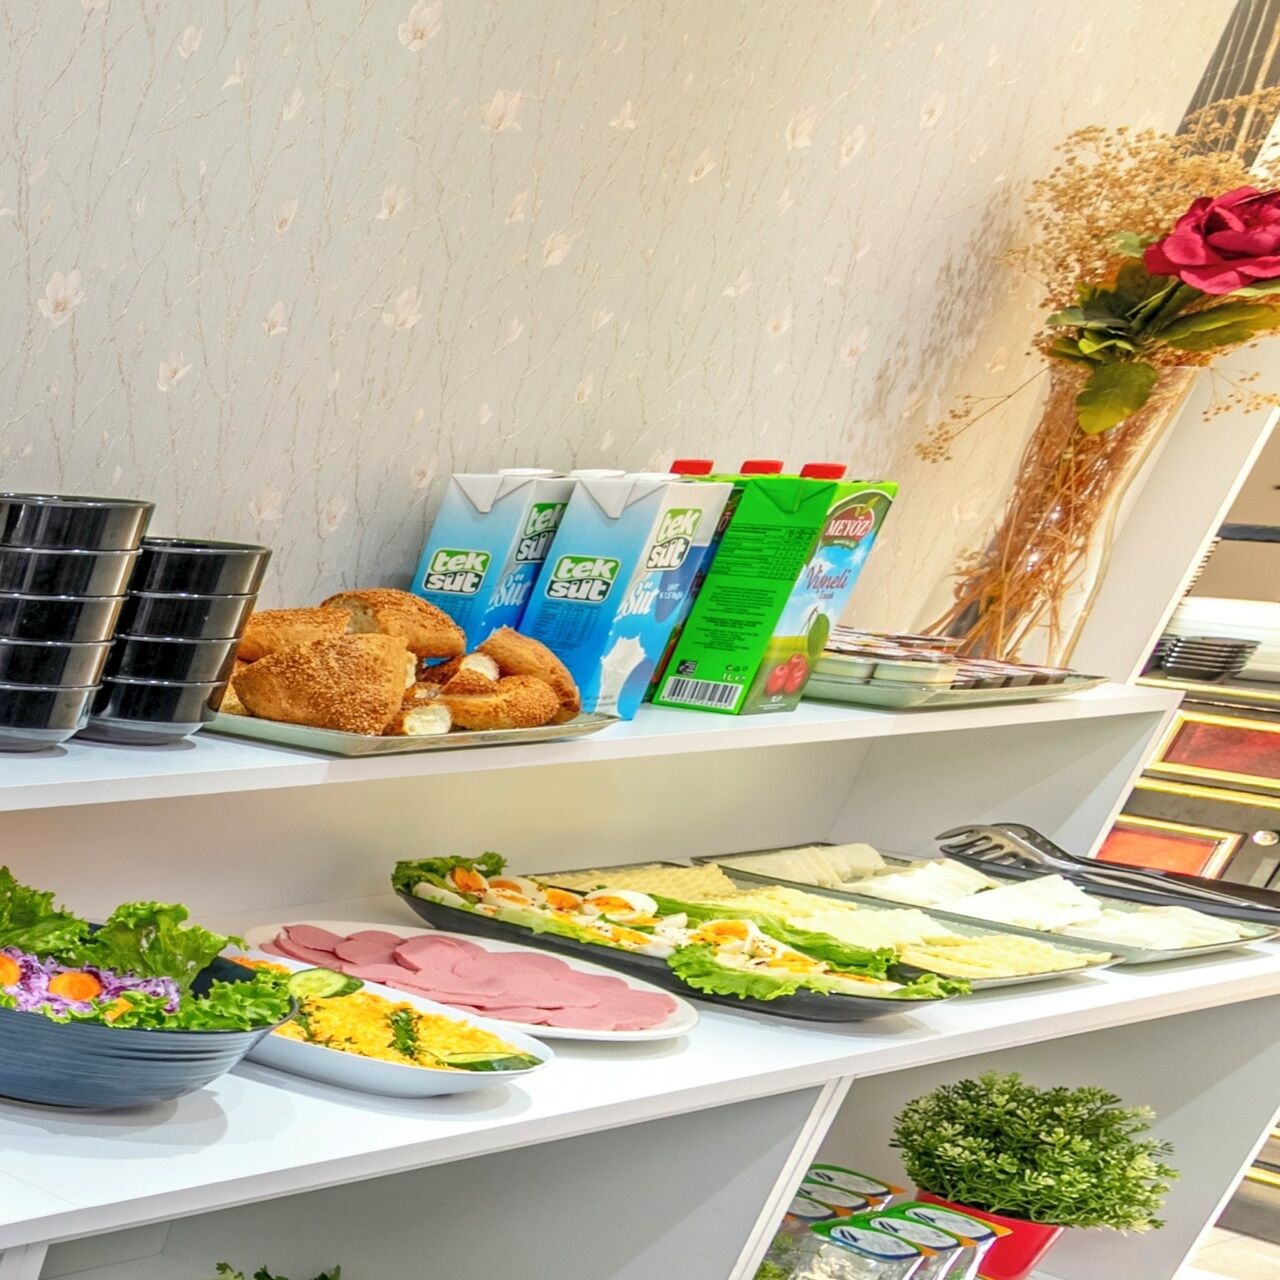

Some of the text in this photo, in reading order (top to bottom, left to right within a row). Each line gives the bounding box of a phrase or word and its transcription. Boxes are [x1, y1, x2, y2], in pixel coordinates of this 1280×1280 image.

[657, 509, 701, 541] tek
[824, 516, 871, 537] MEYÖZ
[433, 552, 488, 573] tek
[646, 538, 687, 568] süt
[557, 556, 617, 580] tek
[426, 572, 482, 592] süt
[548, 579, 611, 601] süt
